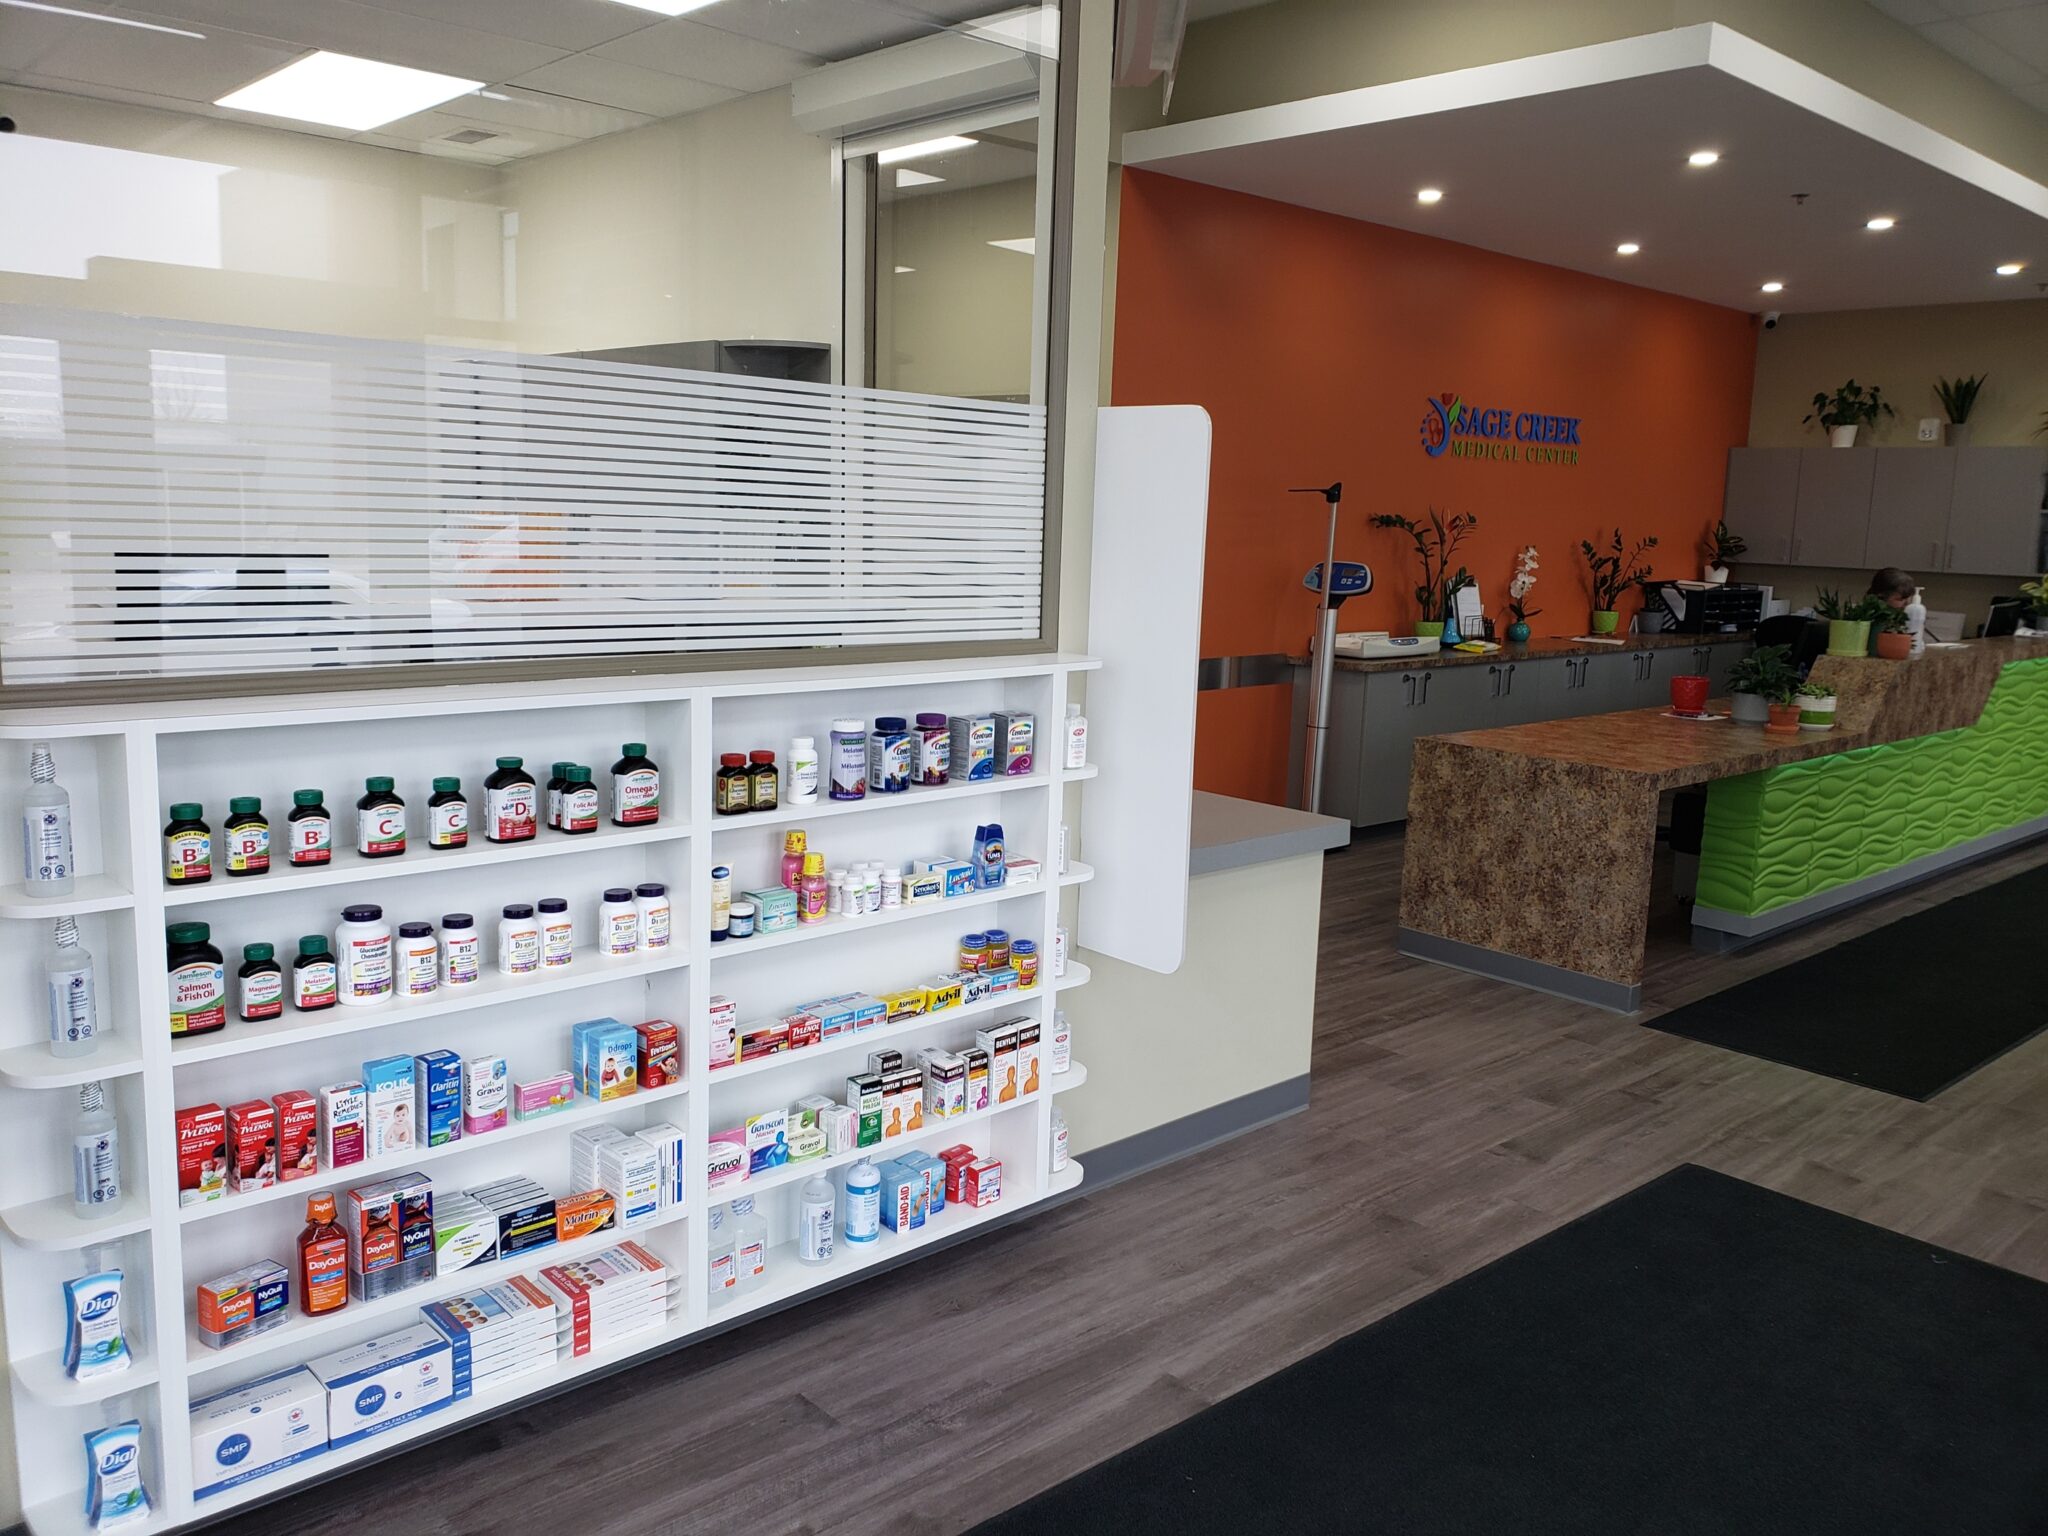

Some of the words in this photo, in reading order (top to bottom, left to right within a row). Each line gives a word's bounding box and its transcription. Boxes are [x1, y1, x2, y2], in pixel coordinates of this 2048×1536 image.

[1454, 404, 1512, 440] SAGE
[1516, 413, 1582, 445] CREEK
[1451, 440, 1520, 462] MEDICAL
[1526, 447, 1579, 465] CENTER
[973, 732, 992, 741] Centrum
[625, 783, 658, 794] Omega-3
[379, 819, 393, 835] C
[448, 814, 460, 828] C
[459, 944, 471, 953] B12
[420, 956, 431, 964] B12
[177, 969, 212, 980] Jamieson
[178, 982, 213, 994] Salmon
[248, 983, 281, 993] Magnesium
[967, 984, 990, 998] Advil
[184, 991, 203, 1002] Fish
[203, 989, 215, 999] Oil
[934, 987, 961, 1004] Advil
[897, 998, 921, 1008] ASPIRIN
[792, 1023, 820, 1037] TYLENOL
[1020, 1028, 1040, 1040] BENYLIN
[608, 1042, 633, 1054] Ddrops
[996, 1036, 1017, 1048] BENYLIN
[883, 1059, 902, 1069] BENYLIN
[970, 1058, 988, 1067] BENYLIN
[947, 1067, 963, 1077] BENYLIN
[376, 1077, 410, 1092] KOLIK
[431, 1080, 459, 1093] Claritin
[902, 1076, 922, 1086] BENYLIN
[476, 1084, 504, 1097] Gravol
[333, 1100, 364, 1118] REMEDIES
[335, 1096, 359, 1110] LITTLE
[283, 1112, 315, 1125] TYLENOL
[751, 1117, 785, 1134] Gaviscon
[180, 1123, 223, 1140] TYLENOL
[240, 1121, 273, 1135] TYLENOL
[181, 1143, 196, 1151] Fever
[203, 1139, 216, 1147] Pain
[800, 1139, 821, 1151] Gravol
[708, 1155, 742, 1174] Gravol
[314, 1201, 333, 1213] DayQuil
[899, 1186, 910, 1227] BAND-AID
[564, 1209, 599, 1226] Motrin
[403, 1229, 430, 1244] NyQuil
[366, 1240, 395, 1254] DayQuil
[308, 1254, 345, 1271] DayQuil
[258, 1284, 283, 1300] NyQuil
[82, 1294, 117, 1314] Dial
[222, 1296, 252, 1314] DayQuil
[358, 1393, 383, 1408] SMP
[221, 1442, 248, 1458] SMP
[102, 1447, 136, 1468] Dial
